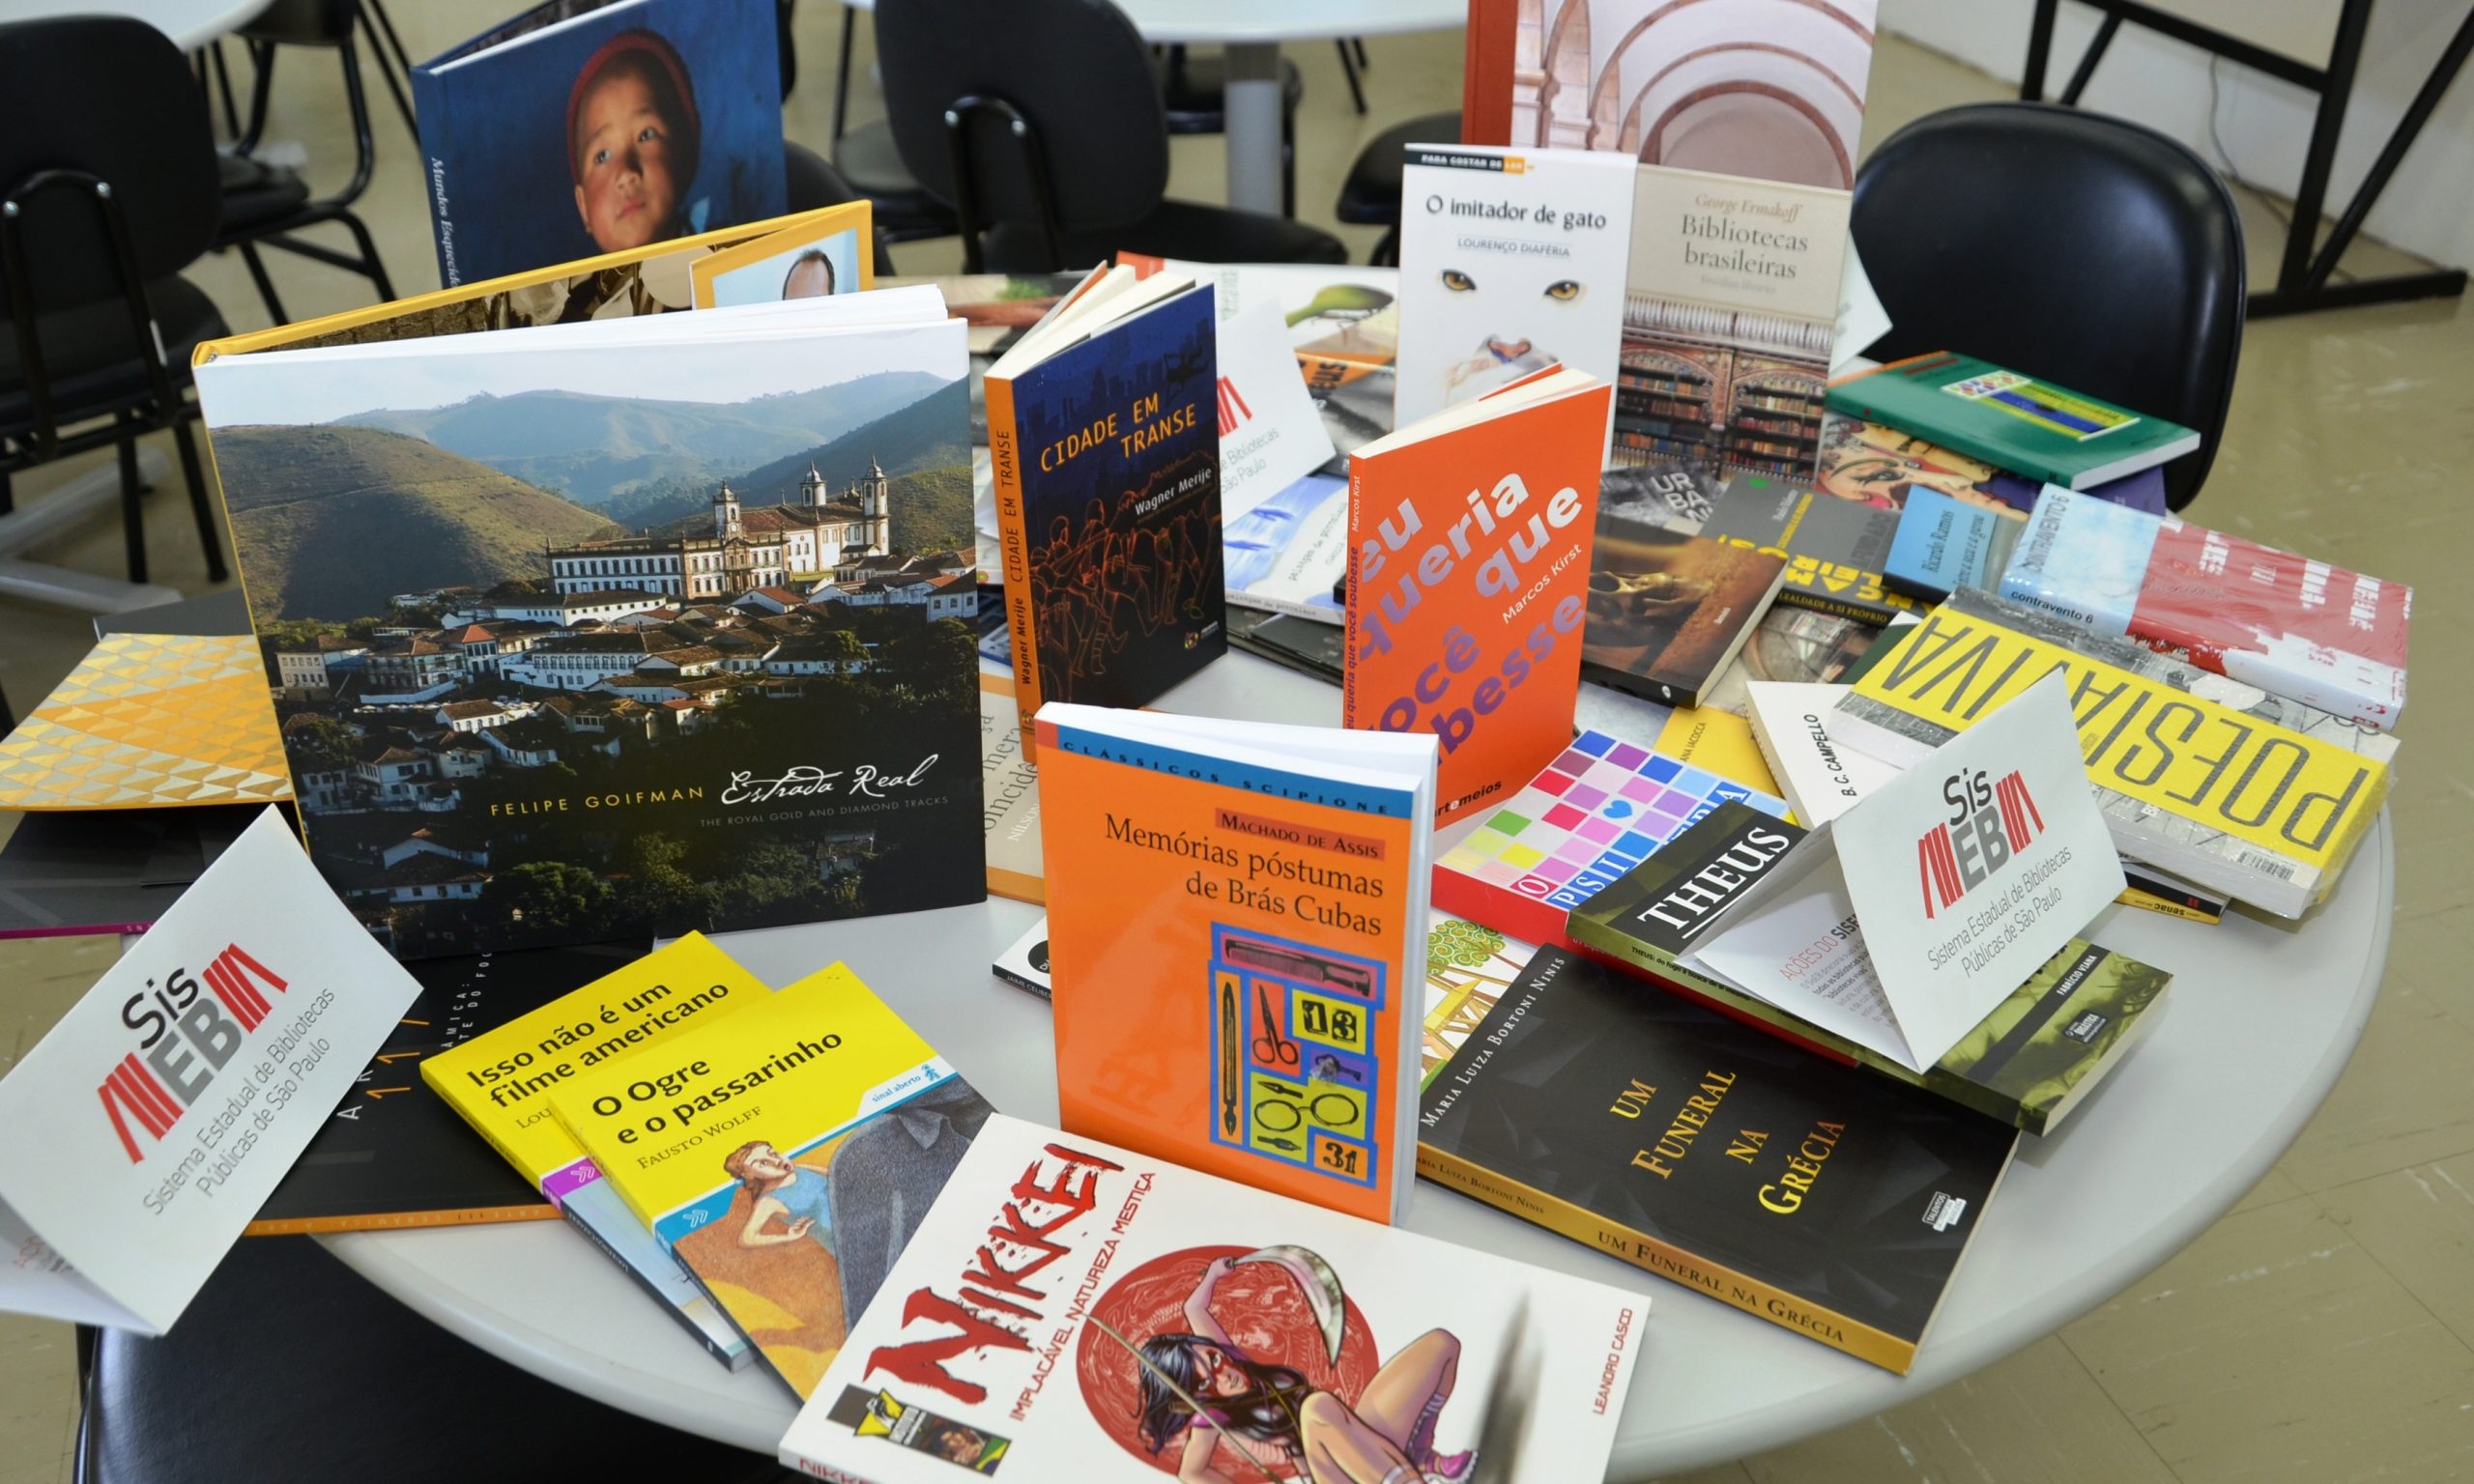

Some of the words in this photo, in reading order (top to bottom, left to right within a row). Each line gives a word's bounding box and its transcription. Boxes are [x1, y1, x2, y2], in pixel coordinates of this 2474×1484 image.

[431, 157, 448, 216] Mundos
[1421, 154, 1448, 164] PARA
[1450, 156, 1487, 167] GOSTAR
[1489, 158, 1503, 169] DE
[1425, 194, 1444, 214] O
[1451, 197, 1528, 220] imitador
[1534, 204, 1556, 224] de
[1563, 211, 1606, 231] gato
[1682, 214, 1808, 251] Bibliotecas
[1695, 193, 1739, 214] George
[1741, 200, 1803, 223] Ermakoff
[1457, 238, 1517, 254] LOURENÇO
[1520, 242, 1570, 257] DIAFÉRIA
[1684, 242, 1797, 278] brasileiras
[1040, 413, 1118, 472] CIDADE
[1133, 392, 1159, 424] EM
[1120, 403, 1196, 459] TRANSE
[1227, 428, 1280, 463] Bibliotecas
[1001, 431, 1011, 488] TRANSE
[1237, 460, 1267, 483] Paulo
[1651, 472, 1695, 493] UR
[1004, 498, 1017, 517] EM
[1135, 487, 1176, 516] Wagner
[1178, 468, 1212, 494] Merije
[1352, 499, 1361, 532] Marcos
[1667, 492, 1711, 511] BA
[1362, 498, 1424, 583] eu
[1475, 487, 1582, 599] que
[1931, 509, 1954, 542] Ramos
[1007, 528, 1022, 583] CIDADE
[1349, 547, 1359, 609] soubesse
[1359, 471, 1530, 663] queria
[1921, 541, 1944, 573] Ricardo
[1502, 574, 1551, 625] Marcos
[1552, 544, 1582, 578] Kirst
[1778, 592, 1826, 610] LEALDADE
[1848, 607, 1887, 623] PRÓPRIO
[2011, 590, 2083, 621] contravento
[2086, 614, 2094, 624] 6
[1017, 597, 1026, 637] Merije
[1346, 612, 1357, 642] você
[1020, 641, 1031, 685] Wagner
[1347, 644, 1358, 670] que
[1366, 625, 1481, 732] ocê
[1430, 592, 1586, 763] besse
[1882, 616, 2068, 719] IVA
[1345, 671, 1357, 713] queria
[1688, 723, 1708, 750] IACOCCA
[1803, 714, 1843, 771] CAMPELLO
[2069, 671, 2369, 851] POESIA
[490, 799, 569, 817] FELIPE
[585, 786, 705, 809] GOIFMAN
[721, 765, 844, 805] Estrada
[849, 754, 939, 798] Real
[1064, 741, 1220, 783] CLÁSSICOS
[1244, 781, 1388, 814] SCIPIONE
[1834, 774, 1850, 785] C.
[1841, 786, 1856, 797] B.
[1942, 767, 1992, 826] Sis
[700, 818, 722, 828] THE
[727, 814, 765, 826] ROYAL
[769, 811, 803, 821] GOLD
[808, 808, 835, 818] AND
[840, 802, 900, 815] DIAMOND
[905, 796, 950, 809] TRACKS
[1105, 813, 1239, 868] Memórias
[1249, 850, 1384, 899] póstumas
[1638, 826, 1790, 930] THEUS
[1186, 870, 1219, 899] de
[1227, 878, 1285, 915] Brás
[1294, 895, 1382, 936] Cubas
[1517, 878, 1549, 896] O
[1928, 928, 1971, 971] Sistema
[1969, 896, 2012, 940] Estadual
[2011, 882, 2025, 901] de
[2023, 844, 2072, 891] Bibliotecas
[2154, 902, 2185, 916] senac
[1631, 946, 1655, 962] THEUS:
[1656, 957, 1666, 966] do
[1779, 944, 1823, 982] AÇÕES
[1816, 935, 1838, 957] DO
[1830, 914, 1859, 941] SISE
[1961, 936, 2006, 979] Públicas
[2004, 922, 2017, 941] de
[2014, 908, 2036, 933] São
[2034, 885, 2061, 922] Paulo
[468, 990, 481, 1008] DO
[2057, 969, 2083, 997] FABRÍCIO
[2078, 954, 2097, 977] VIANA
[122, 966, 199, 1050] Sis
[466, 1045, 534, 1090] Isso
[537, 1019, 596, 1059] não
[600, 998, 620, 1026] é
[624, 981, 674, 1015] um
[490, 1060, 576, 1109] filme
[579, 979, 730, 1068] americano
[1421, 1088, 1461, 1127] MARIA
[1455, 1048, 1494, 1086] LUIZA
[1487, 992, 1537, 1046] BORTONI
[1531, 956, 1566, 992] NINIS
[143, 1146, 206, 1216] Sistema
[195, 1081, 262, 1150] Estadual
[255, 1062, 275, 1086] de
[266, 986, 335, 1065] Bibliotecas
[591, 1095, 622, 1118] O
[627, 1058, 711, 1106] Ogre
[617, 1125, 639, 1146] e
[645, 1113, 667, 1133] o
[672, 1029, 844, 1127] passarinho
[871, 1085, 894, 1104] sinal
[890, 1073, 922, 1095] aberto
[1610, 1078, 1658, 1120] UM
[195, 1129, 260, 1198] Públicas
[255, 1109, 275, 1132] de
[266, 1081, 296, 1112] São
[289, 1035, 331, 1086] Paulo
[637, 1135, 704, 1170] FAUSTO
[706, 1106, 762, 1137] WOLFF
[1631, 1070, 1736, 1181] FUNERAL
[1323, 1142, 1358, 1174] 31
[1417, 1156, 1436, 1171] ARIA
[1725, 1127, 1769, 1164] NA
[1757, 1119, 1846, 1214] GRÉCIA
[862, 1142, 1125, 1406] NIKKEI
[1009, 1325, 1075, 1422] IMPLACÁVEL
[1067, 1239, 1119, 1322] NATUREZA
[1111, 1171, 1157, 1236] MESTIÇA
[1597, 1230, 1626, 1253] UM
[1636, 1242, 1724, 1293] FUNERAL
[1732, 1285, 1758, 1307] NA
[1768, 1298, 1844, 1343] GRÉCIA
[1593, 1353, 1620, 1415] LEANDRO
[1611, 1307, 1633, 1351] CASCO
